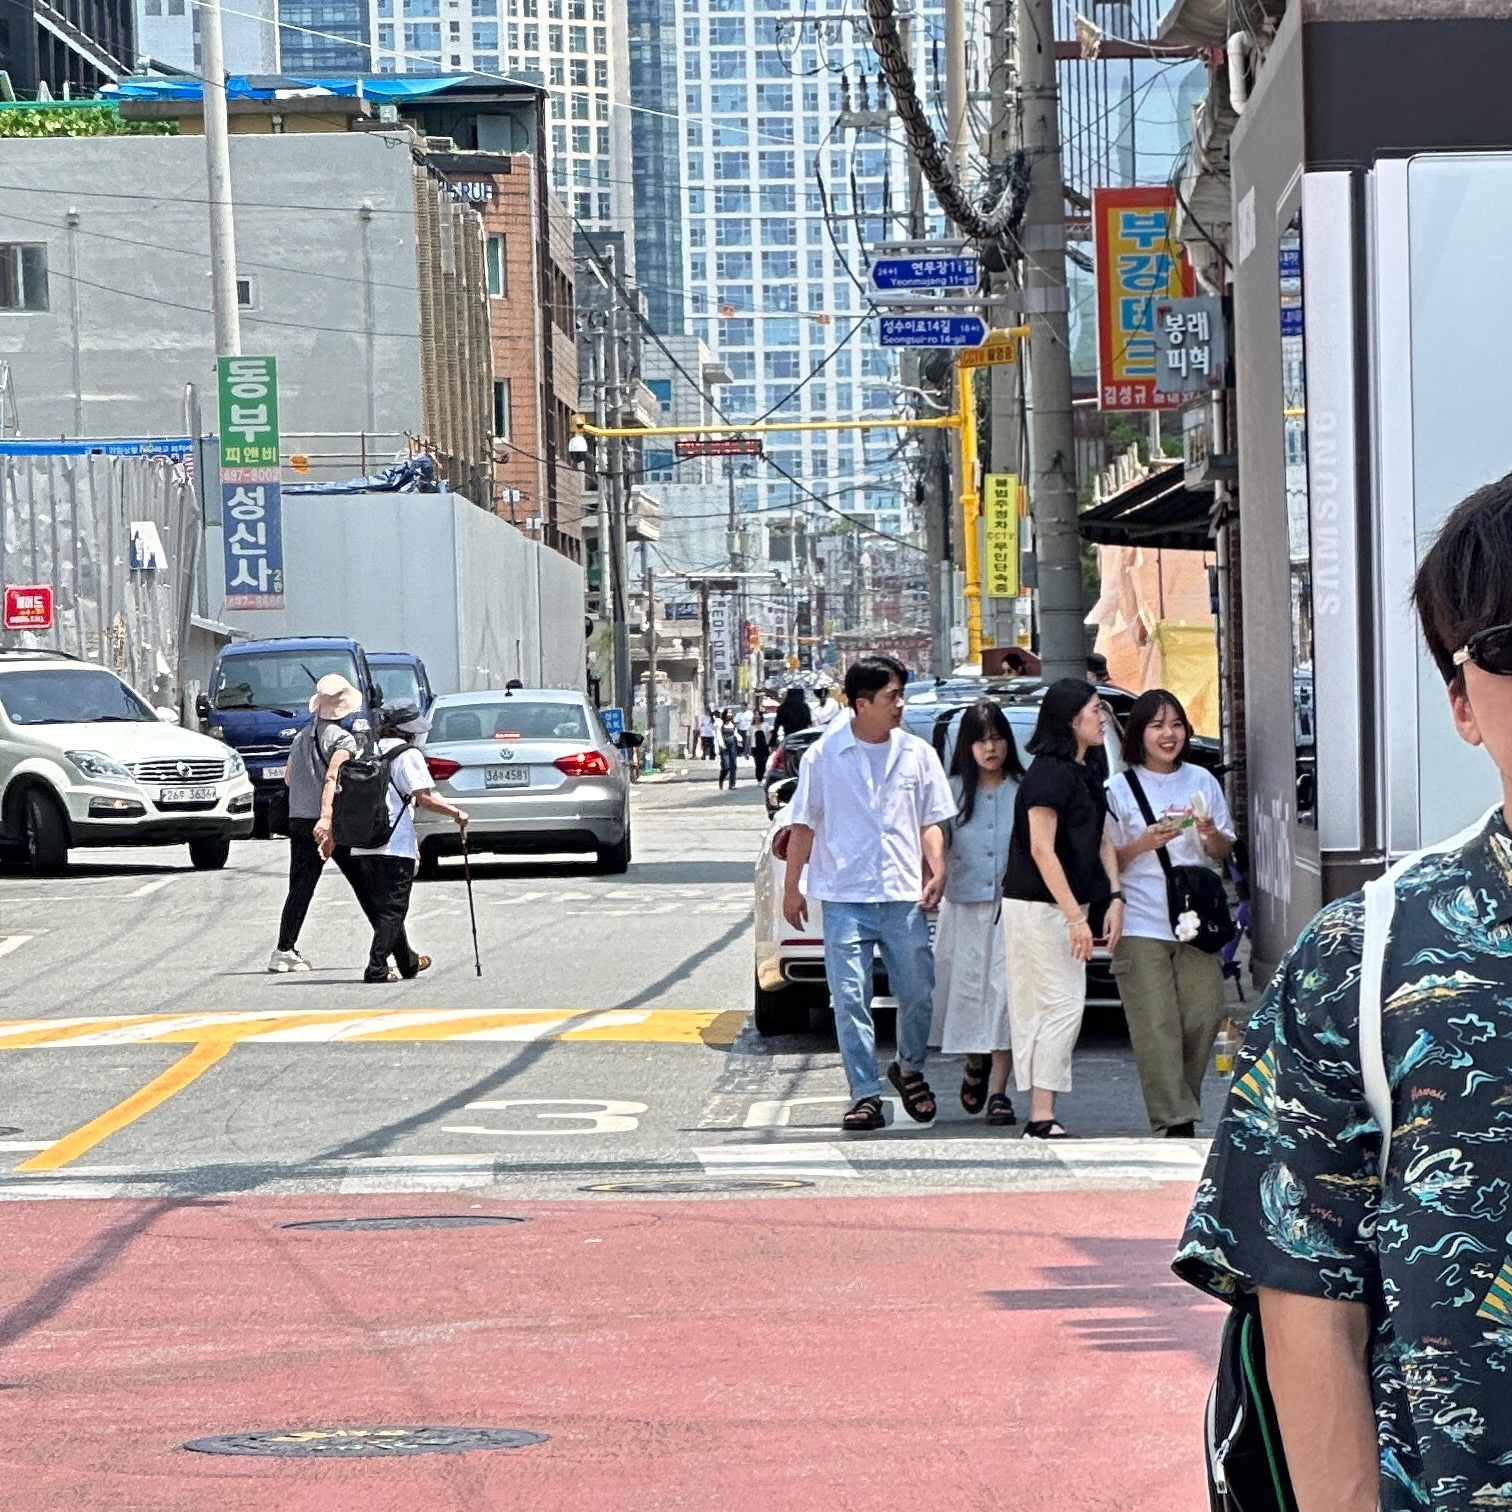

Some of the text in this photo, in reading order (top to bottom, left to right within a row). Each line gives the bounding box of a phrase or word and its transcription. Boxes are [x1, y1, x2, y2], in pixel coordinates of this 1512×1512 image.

[883, 319, 951, 334] 성수이로14길
[940, 334, 966, 345] 14-gil
[1164, 310, 1210, 345] 봉래
[1166, 345, 1210, 379] 피혁
[226, 360, 271, 443] 동부
[1104, 384, 1147, 406] 김성규
[225, 446, 277, 463] 피앤비
[1312, 410, 1341, 616] SAMSUNG
[227, 486, 272, 592] 성신사
